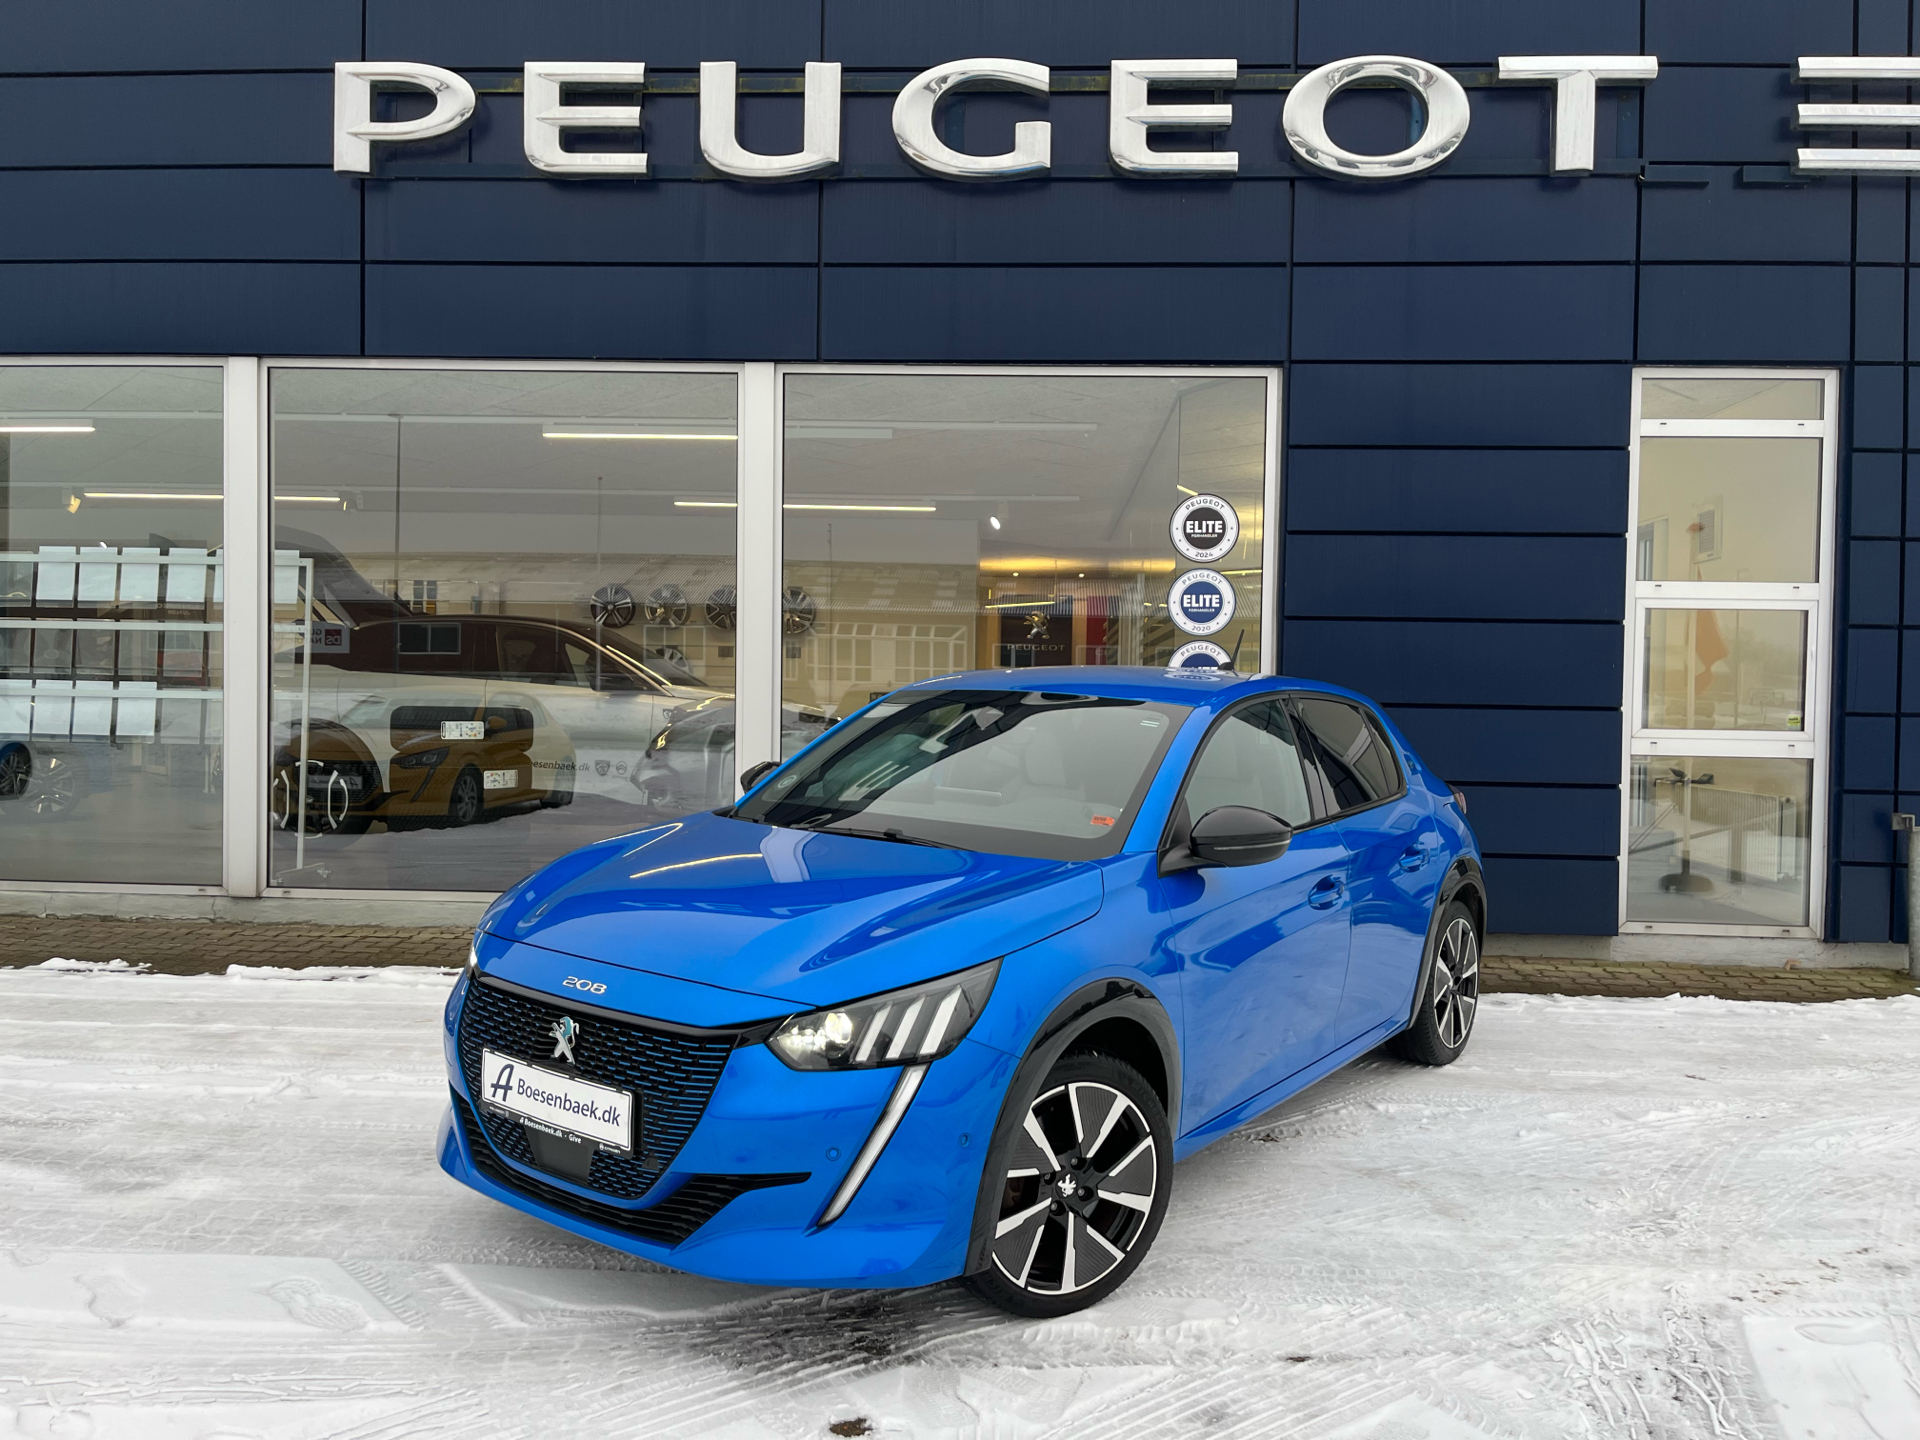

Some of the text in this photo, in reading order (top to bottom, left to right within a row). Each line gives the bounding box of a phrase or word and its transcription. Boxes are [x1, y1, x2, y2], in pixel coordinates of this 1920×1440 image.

[333, 53, 1659, 181] PEUGEOT
[1185, 498, 1225, 511] PEUGEOT
[1186, 520, 1223, 533] ELITE
[1181, 572, 1223, 585] PEUGEOT
[1183, 594, 1220, 607] ELITE
[1180, 644, 1222, 657] PEUGEOT
[562, 976, 607, 994] 208
[490, 1063, 621, 1127] A Boesenbaek.dk
[524, 1118, 563, 1138] Boesenbaek.dk
[568, 1133, 582, 1144] Give
